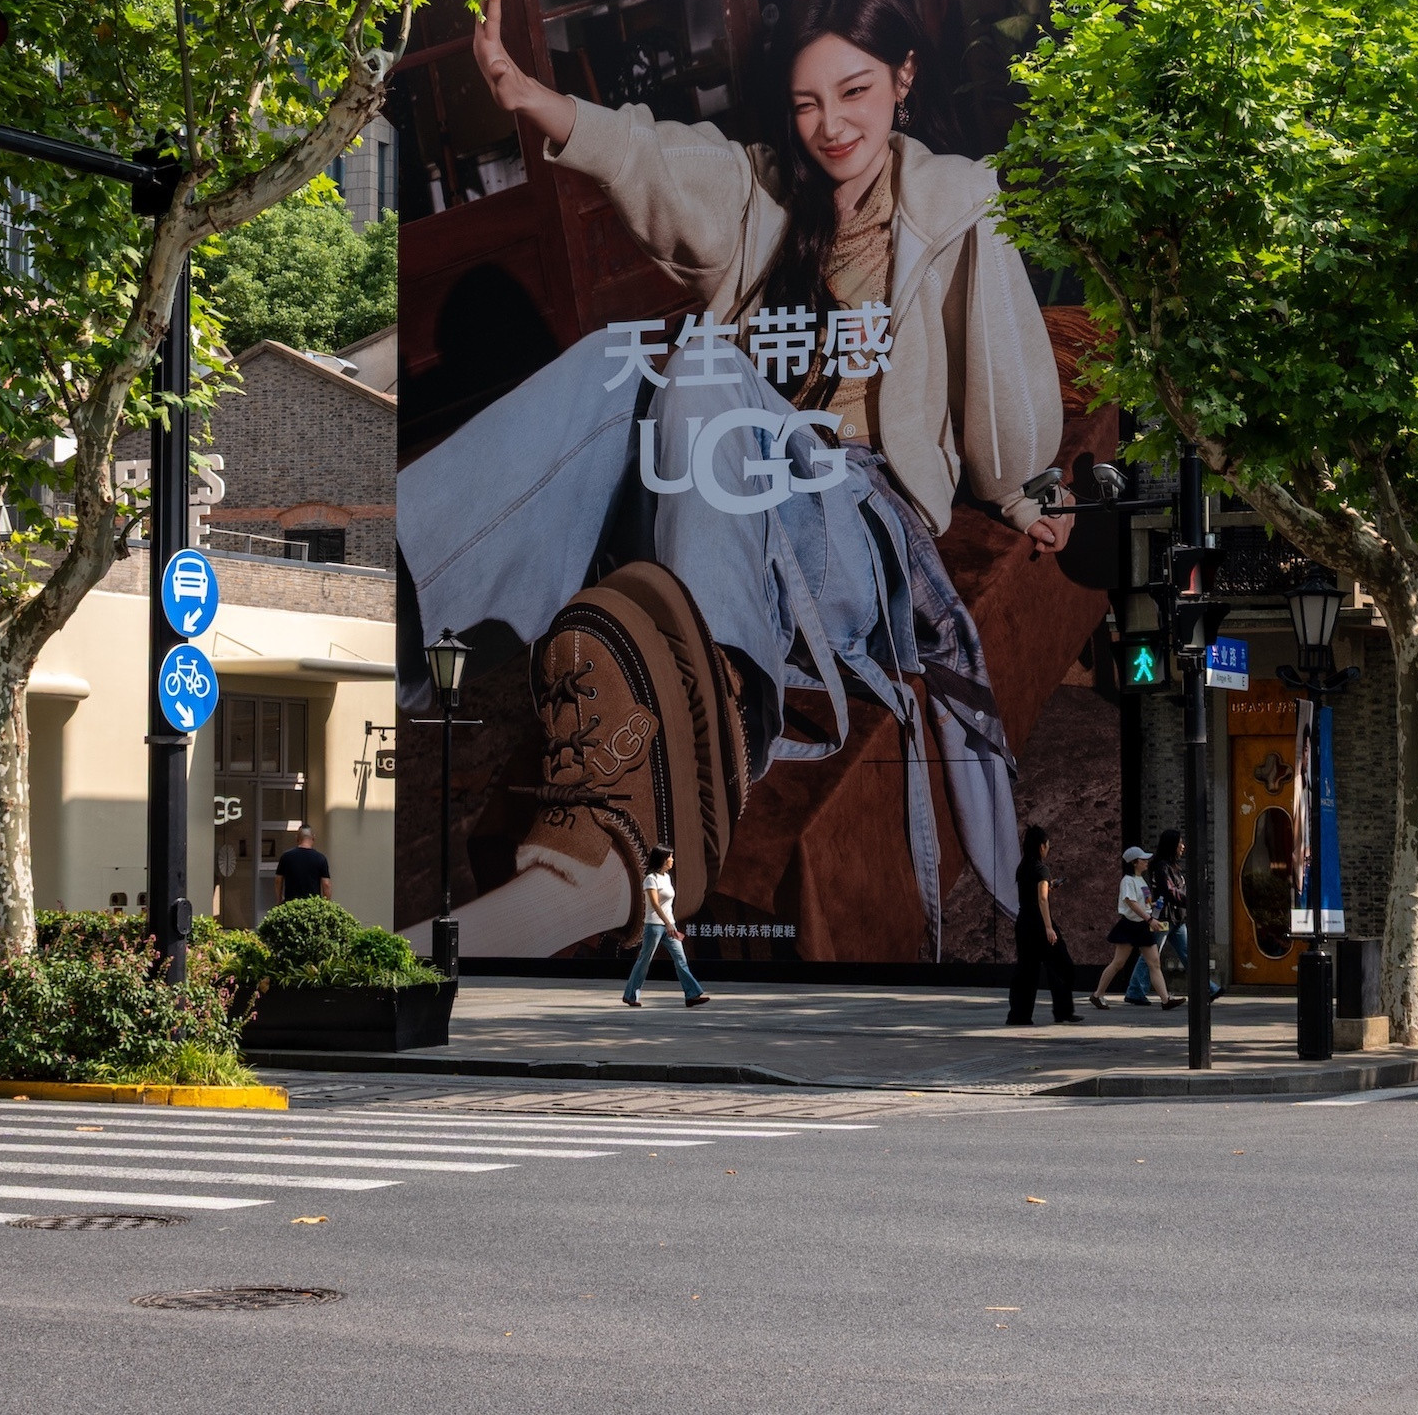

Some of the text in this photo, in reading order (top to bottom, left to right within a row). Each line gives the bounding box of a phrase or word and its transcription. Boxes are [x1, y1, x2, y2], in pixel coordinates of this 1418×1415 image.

[602, 300, 894, 392] 天生带感
[638, 407, 850, 515] UGG
[1211, 645, 1237, 667] 兴业路
[1231, 701, 1273, 713] BEAST
[591, 710, 654, 776] UGG
[376, 756, 397, 772] UG
[214, 795, 243, 826] GG
[700, 923, 797, 938] 经典传承系带便鞋
